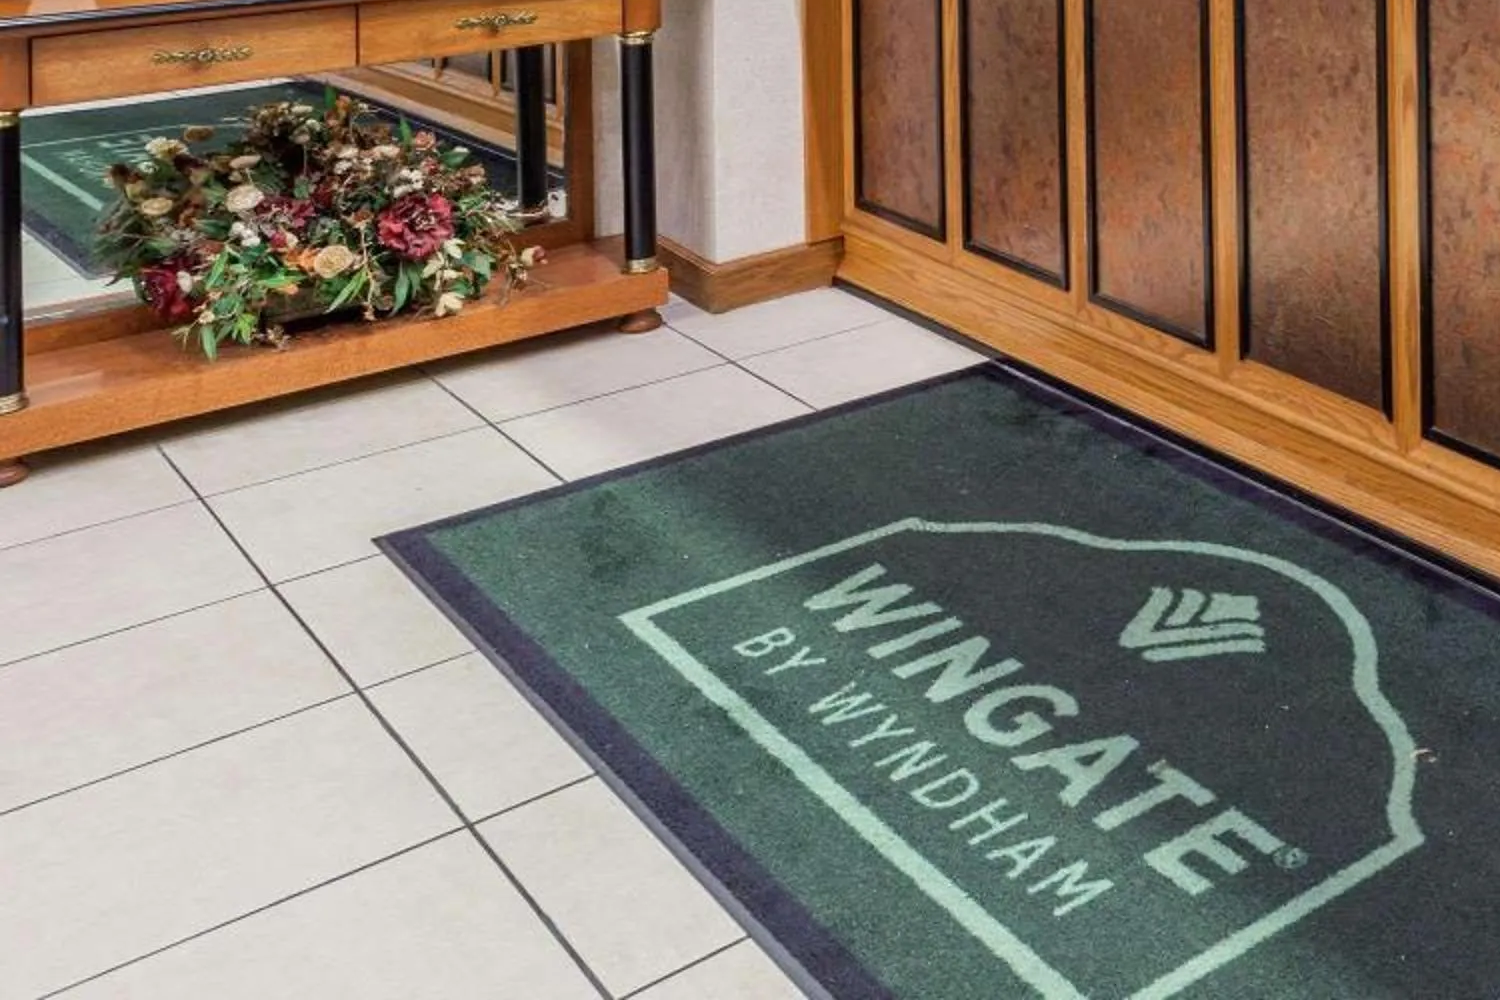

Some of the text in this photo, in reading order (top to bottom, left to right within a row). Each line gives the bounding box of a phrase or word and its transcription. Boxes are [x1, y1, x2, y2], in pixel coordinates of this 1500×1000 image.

[733, 626, 1114, 917] BY WYNDHAM
[804, 564, 1287, 896] WINGATE
